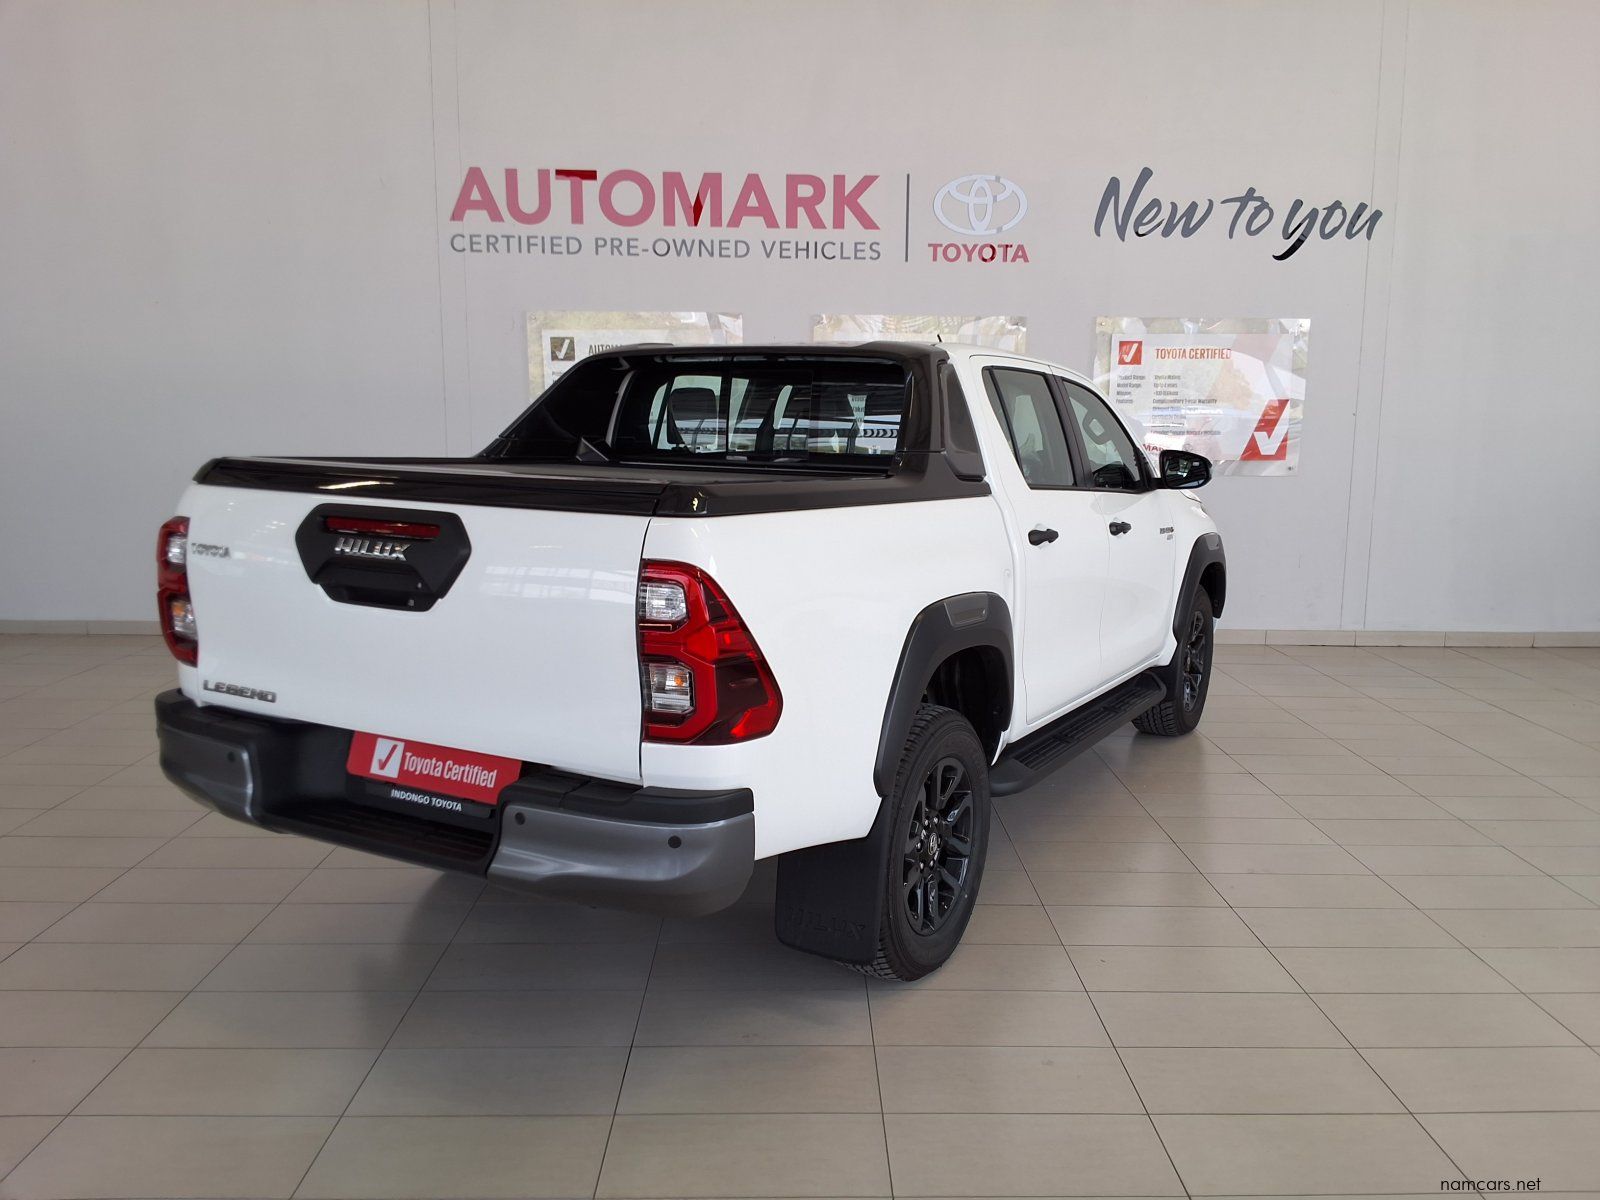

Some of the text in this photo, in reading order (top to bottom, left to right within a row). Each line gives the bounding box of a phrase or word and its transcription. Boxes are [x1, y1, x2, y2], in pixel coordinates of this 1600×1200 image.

[450, 166, 881, 230] AUTOMARK
[1093, 166, 1384, 261] New to you
[450, 233, 881, 261] CERTIFIED PRE-OWNED VEHICLES
[927, 243, 1030, 263] TOYOTA
[1155, 348, 1232, 360] TOYOTA CERTIFIED
[334, 537, 411, 561] HILUX
[404, 752, 498, 788] Toyota Certified
[390, 788, 462, 812] INDONGO TOYOTA
